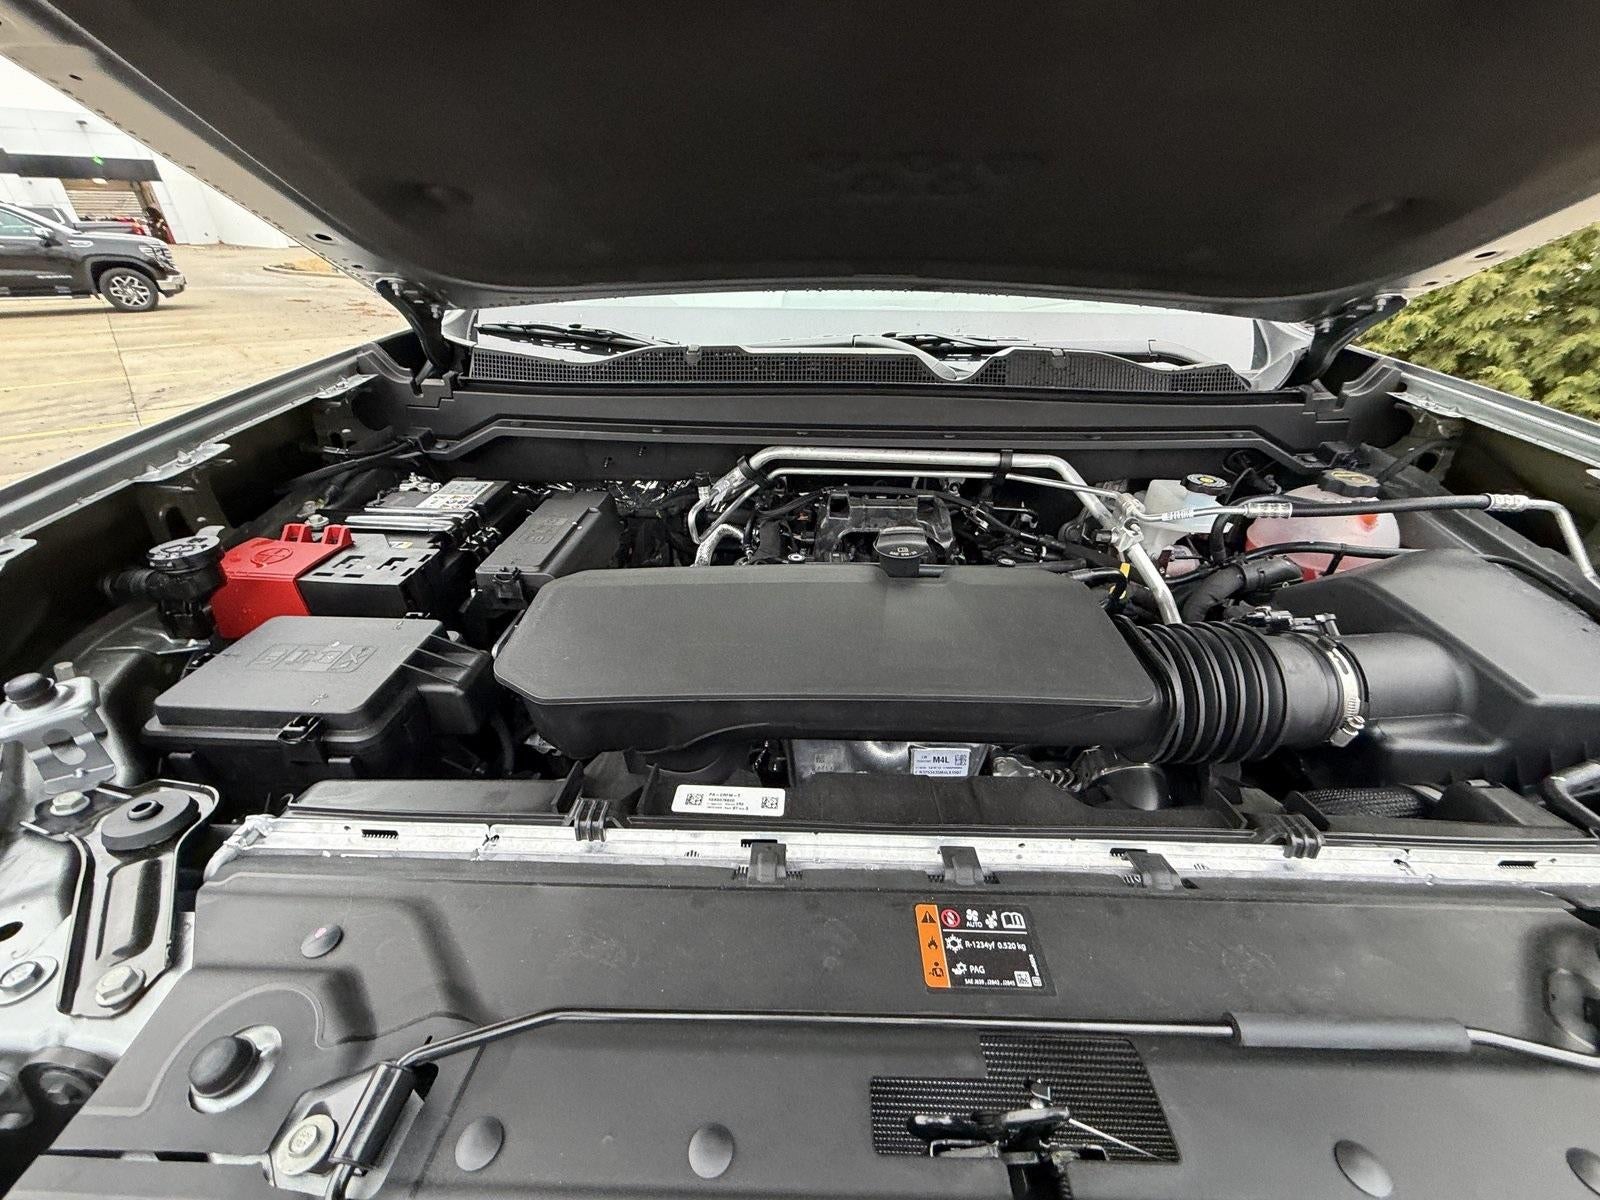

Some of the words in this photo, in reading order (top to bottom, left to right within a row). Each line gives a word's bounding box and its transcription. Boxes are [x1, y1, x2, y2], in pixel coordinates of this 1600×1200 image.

[932, 756, 950, 764] M4L
[965, 941, 995, 950] R-1234yf
[997, 941, 1017, 950] 0.520
[1017, 942, 1027, 952] kg
[970, 965, 985, 973] PAG
